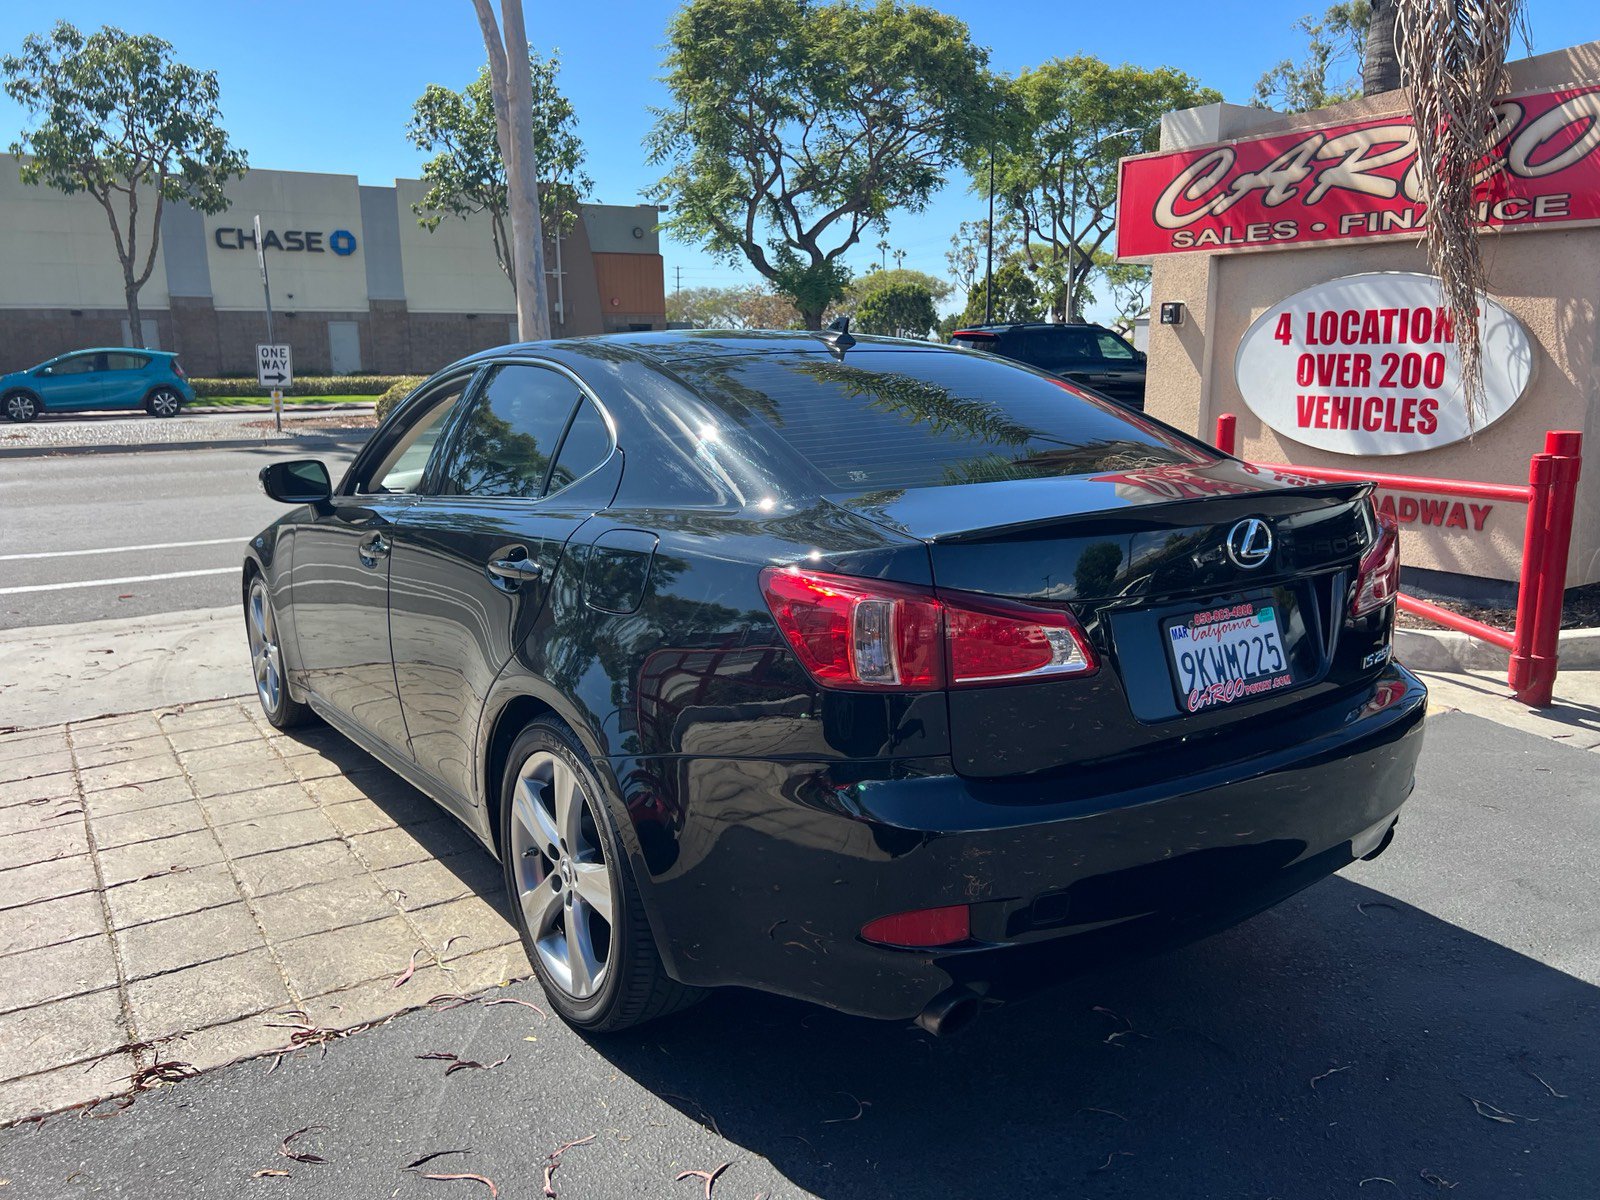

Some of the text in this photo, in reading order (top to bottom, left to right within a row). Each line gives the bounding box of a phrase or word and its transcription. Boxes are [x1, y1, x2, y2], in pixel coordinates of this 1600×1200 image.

[1172, 193, 1571, 249] SALES FINCE
[215, 227, 325, 252] CHASE
[1274, 306, 1480, 346] 4 LOCATION
[261, 348, 287, 358] ONE
[261, 360, 287, 370] WAY
[1296, 352, 1446, 389] OVER 200
[1296, 395, 1439, 435] VEHICLES
[1371, 494, 1492, 530] ADWAY
[1171, 628, 1189, 640] MAR
[1191, 618, 1260, 642] California
[1180, 632, 1282, 693] 9KWM225
[1188, 677, 1245, 712] CARCO
